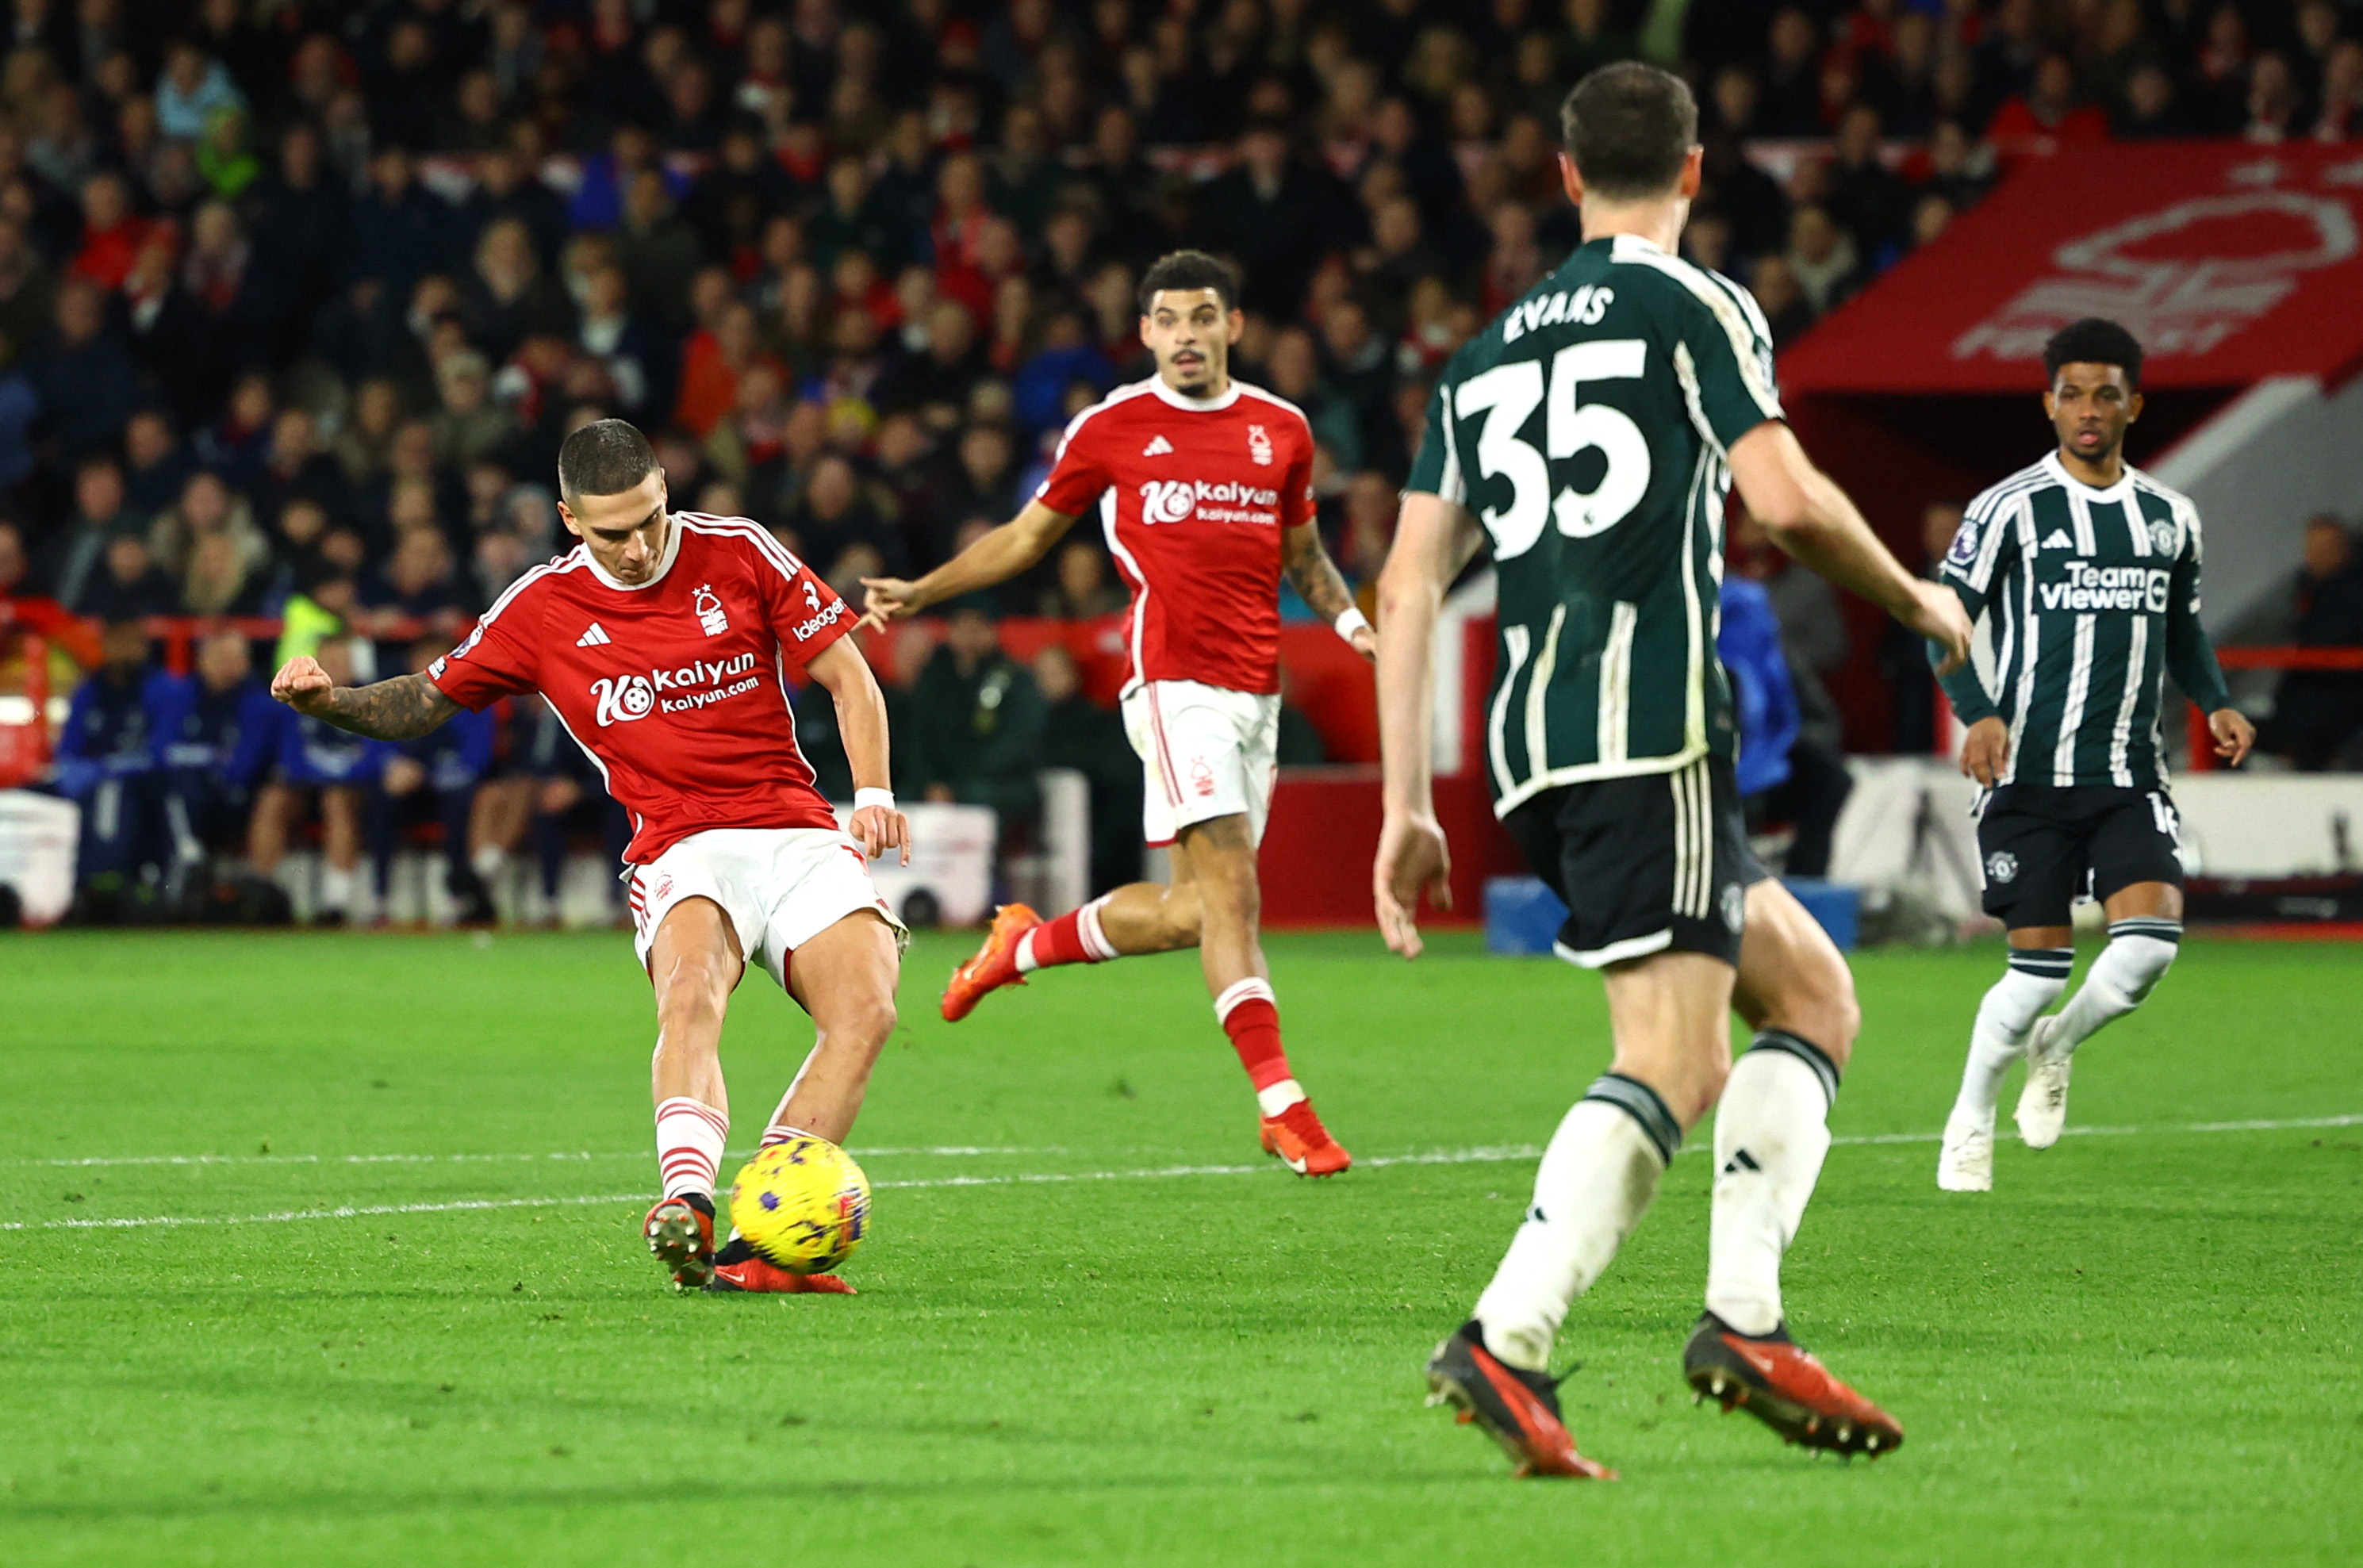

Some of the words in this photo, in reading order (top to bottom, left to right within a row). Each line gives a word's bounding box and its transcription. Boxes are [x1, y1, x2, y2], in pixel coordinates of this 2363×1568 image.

[1503, 283, 1614, 344] EVANS
[1456, 339, 1651, 562] 35
[1195, 479, 1278, 508] kaiyun
[2064, 561, 2146, 588] Team
[2039, 581, 2145, 610] Viewer
[651, 652, 754, 692] kaiyun
[661, 676, 759, 714] kaiyun.com
